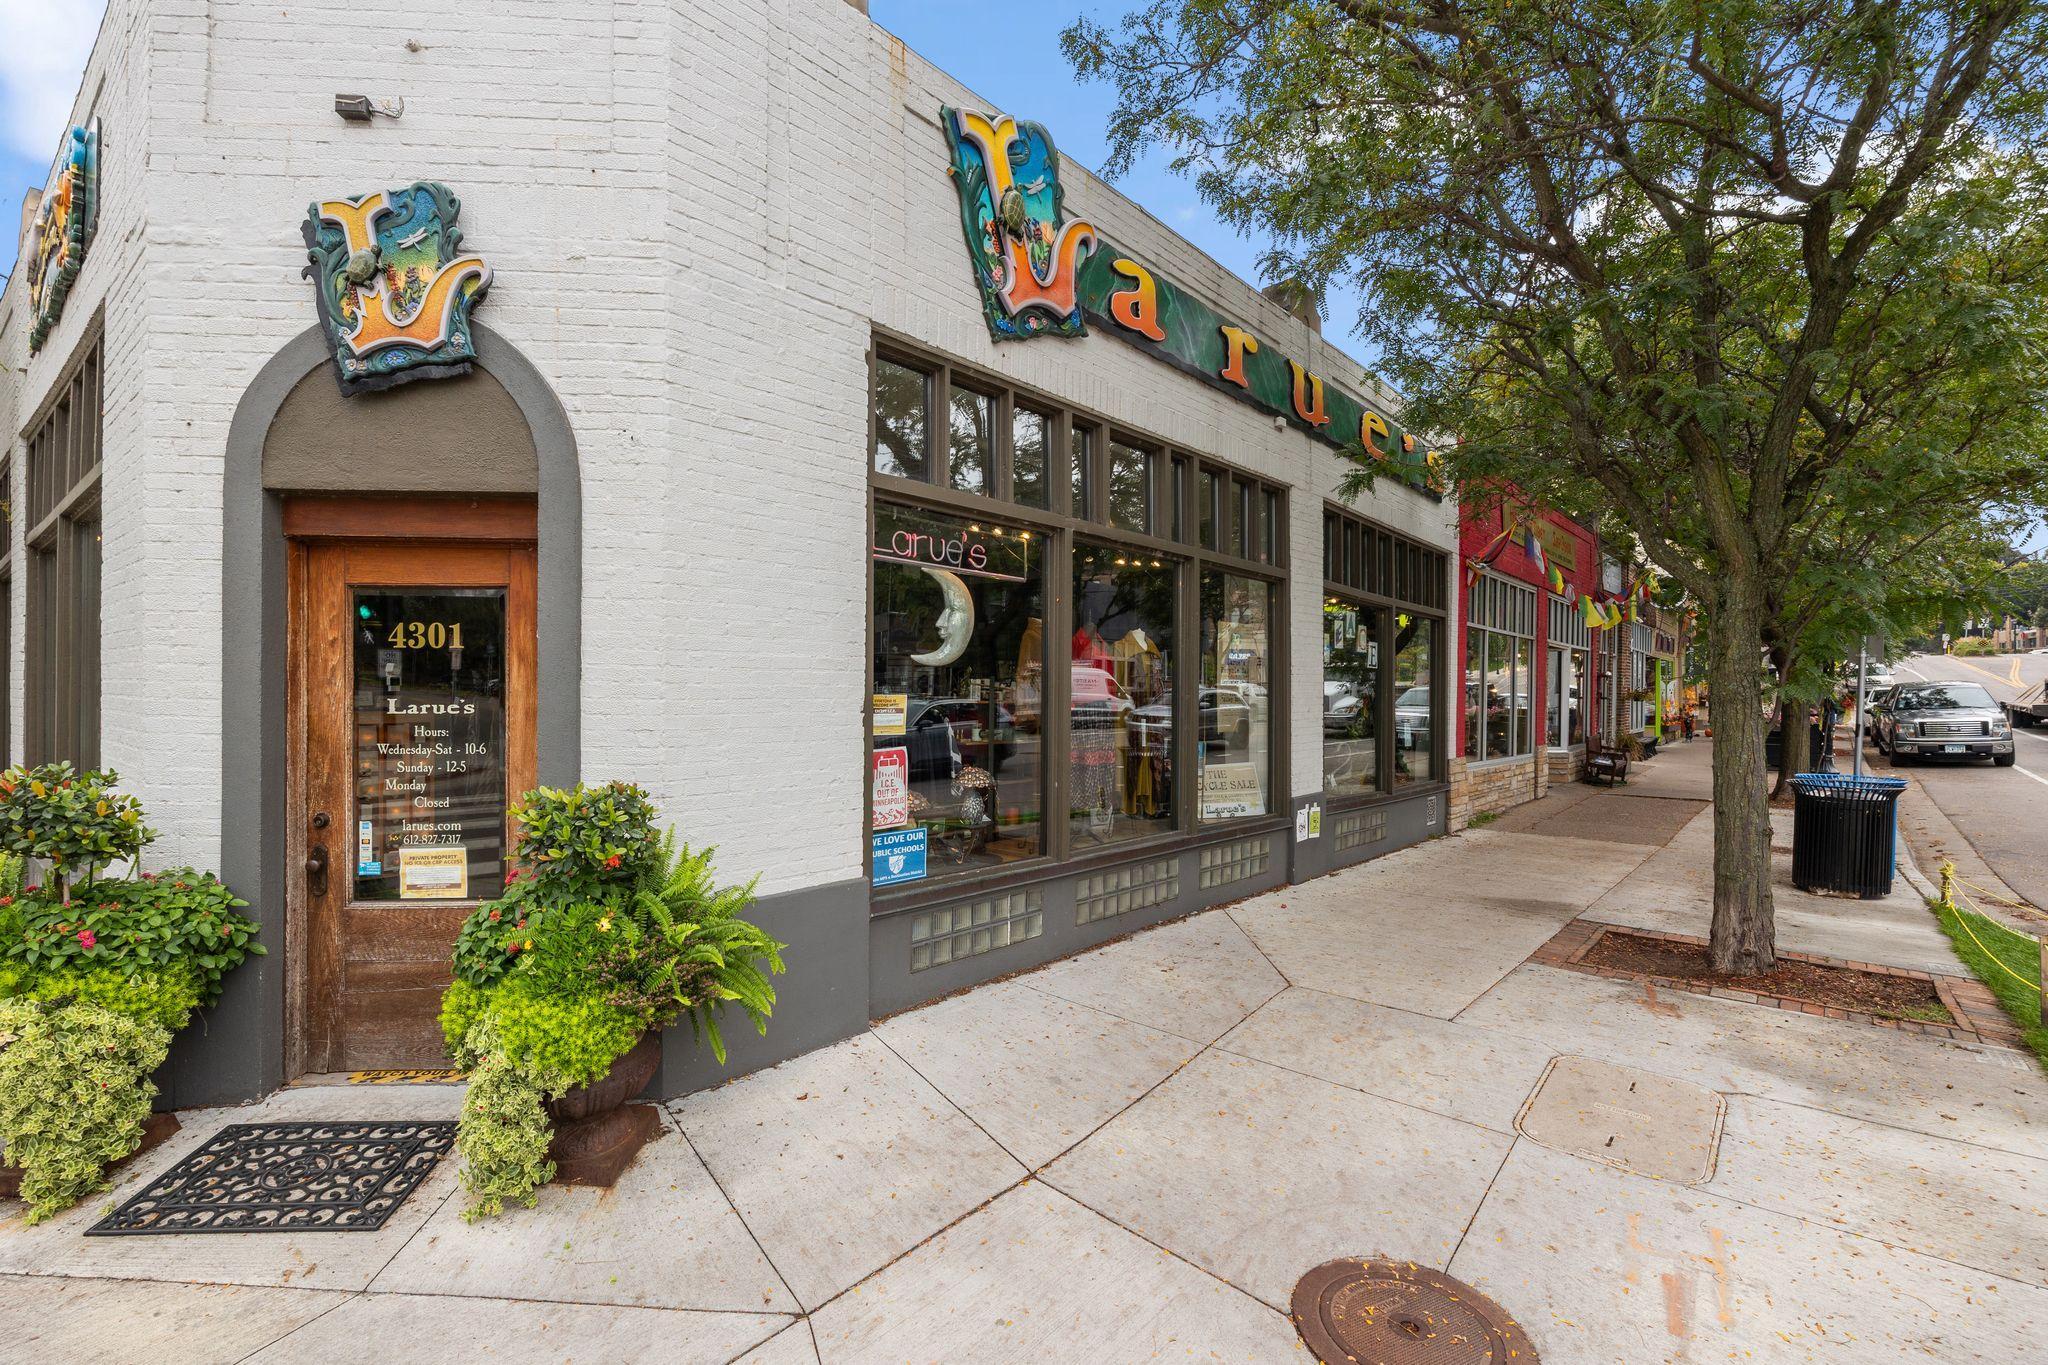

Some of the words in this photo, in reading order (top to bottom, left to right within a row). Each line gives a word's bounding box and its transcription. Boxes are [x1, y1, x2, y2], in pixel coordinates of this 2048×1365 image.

[388, 622, 464, 649] 4301
[387, 698, 475, 714] Larue's
[414, 726, 449, 738] Hours:
[377, 743, 453, 758] Wednesday-Sat
[464, 743, 487, 755] 10-6
[397, 761, 434, 776] Sunday
[446, 761, 467, 772] 12-5
[1206, 770, 1227, 779] THE
[385, 778, 427, 793] Monday
[1230, 780, 1256, 789] SALE
[877, 789, 889, 798] OUT
[891, 788, 899, 796] OF
[414, 796, 450, 808] Closed
[873, 798, 904, 806] INNEAPOLIS
[402, 819, 462, 831] larues.com
[403, 834, 461, 845] 612-827-7317
[884, 834, 905, 845] LOVE
[906, 831, 924, 842] OUR
[873, 848, 892, 858] UBLIC
[893, 843, 925, 855] SCHOOLS
